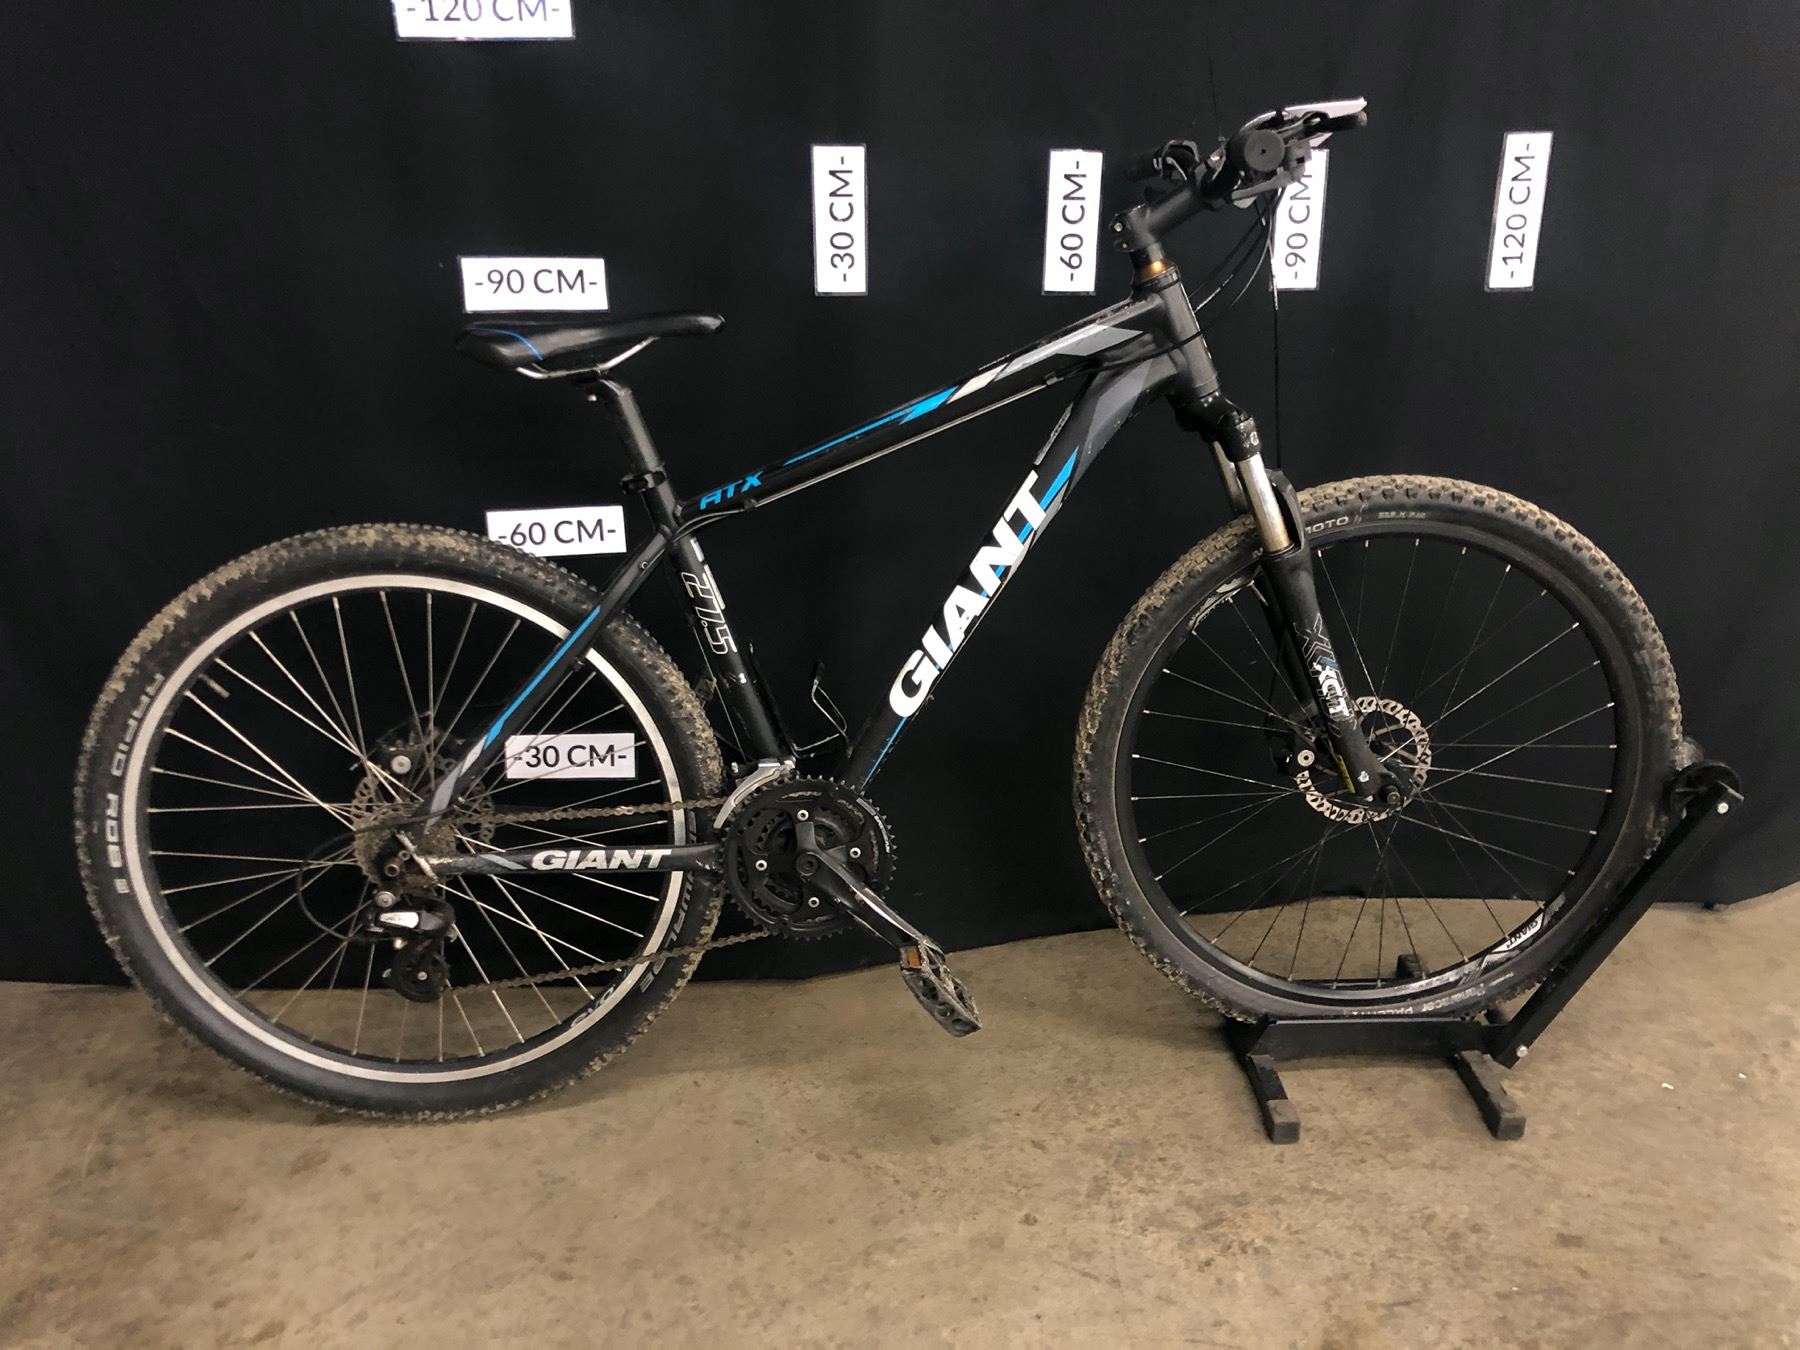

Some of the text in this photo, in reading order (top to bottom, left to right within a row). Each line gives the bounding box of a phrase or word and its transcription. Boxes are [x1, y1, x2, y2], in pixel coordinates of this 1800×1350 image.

[828, 156, 855, 282] -30 CM-
[1059, 160, 1087, 281] -60 CM-
[1284, 174, 1313, 280] -90 CM
[1502, 142, 1535, 280] -120 CM-
[475, 268, 598, 294] -90 CM-
[498, 517, 616, 546] -60 CM-
[700, 471, 764, 510] ATX
[681, 571, 738, 655] 27.5
[889, 469, 1046, 717] GIANT
[110, 673, 165, 777] RAPID
[512, 744, 627, 768] -30 CM-
[105, 793, 122, 868] ROB
[531, 850, 672, 870] GIANT
